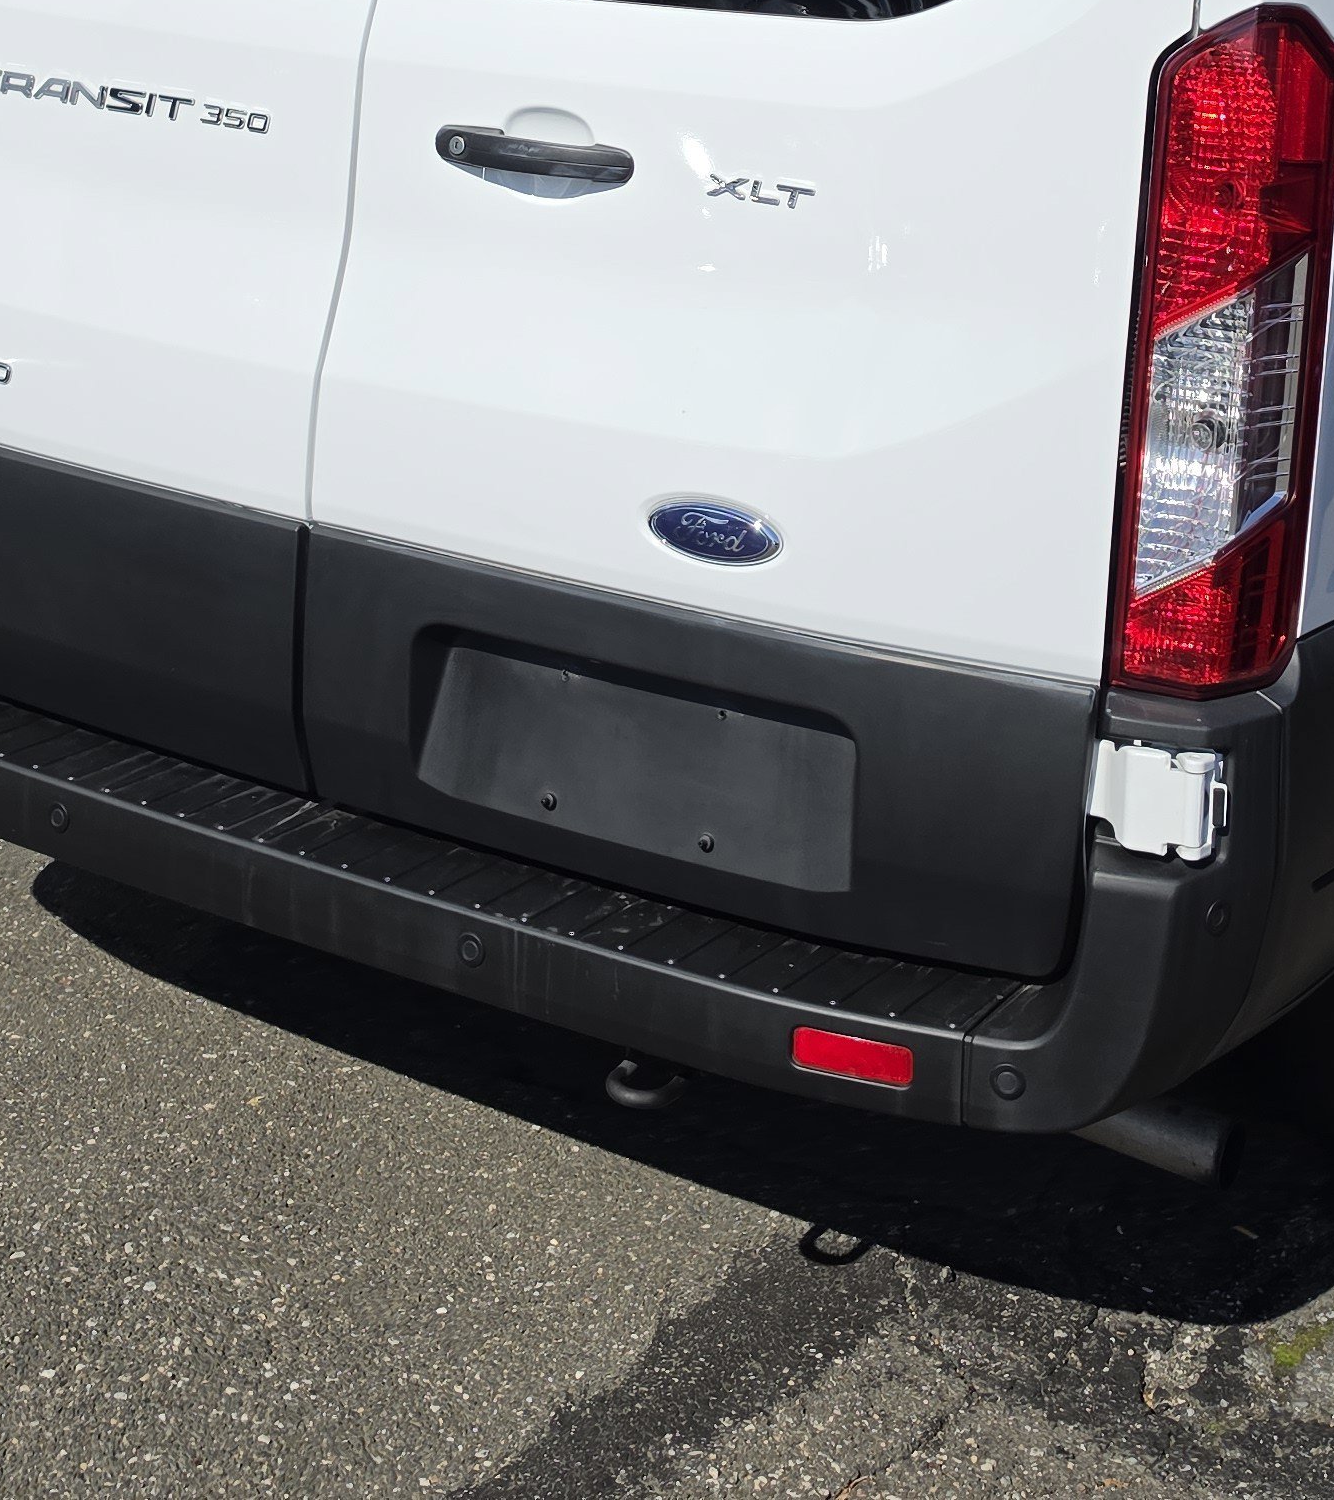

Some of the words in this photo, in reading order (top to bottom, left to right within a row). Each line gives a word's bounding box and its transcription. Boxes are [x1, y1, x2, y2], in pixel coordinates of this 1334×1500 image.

[199, 102, 271, 135] 350
[705, 173, 817, 210] XLT
[673, 511, 748, 553] Ford
